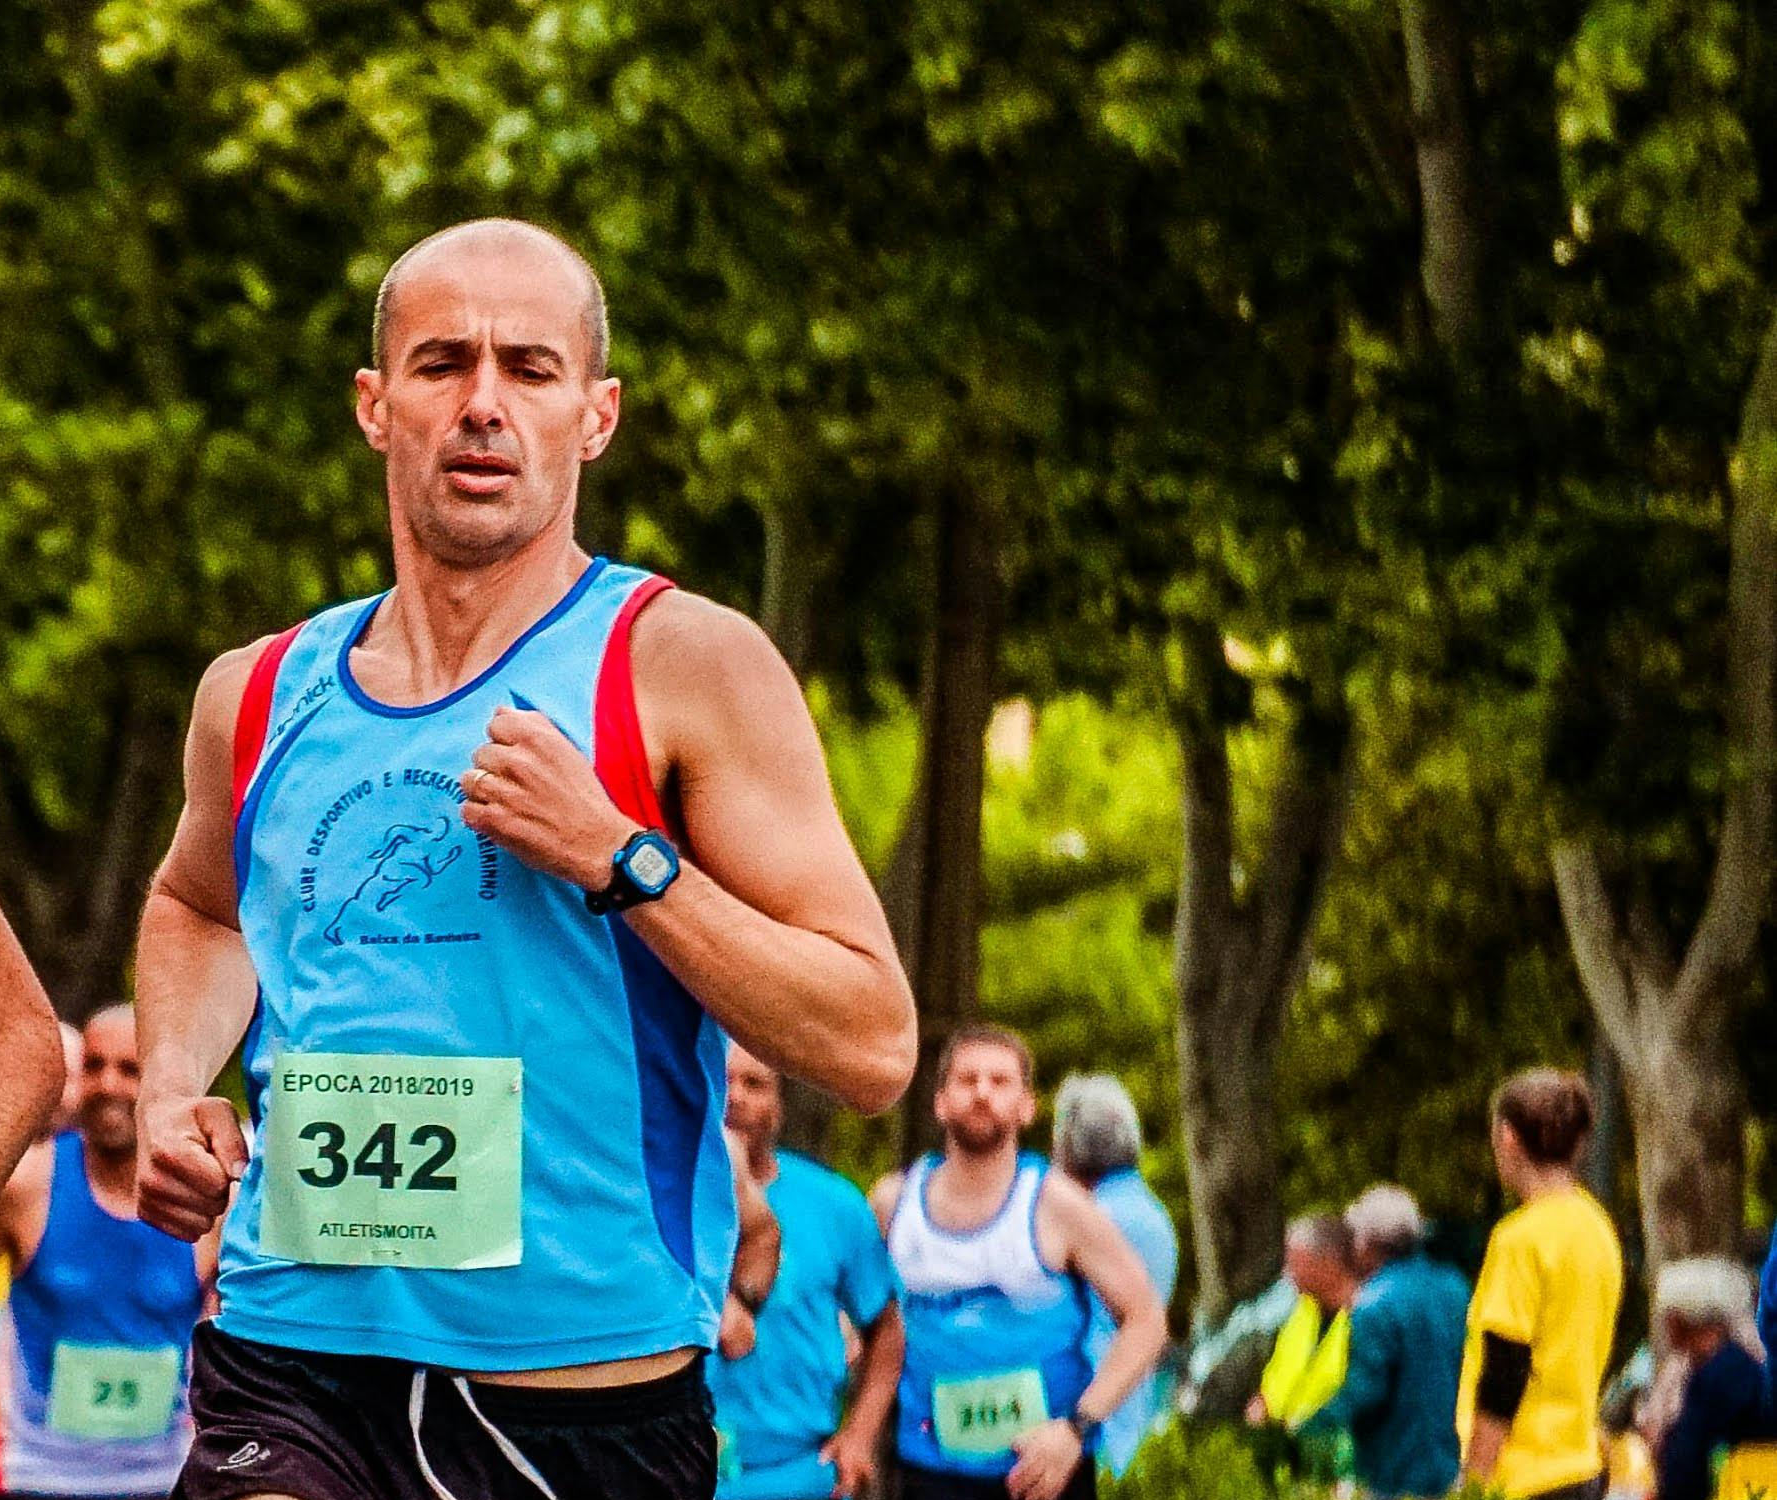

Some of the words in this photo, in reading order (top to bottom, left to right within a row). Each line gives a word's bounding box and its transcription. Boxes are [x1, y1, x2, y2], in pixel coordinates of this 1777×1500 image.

[383, 771, 394, 788] E
[403, 769, 470, 804] RECREATIV
[306, 780, 373, 856] DESPORTIVO
[300, 866, 318, 912] CLUBE
[283, 1069, 364, 1093] ÉPOCA
[369, 1075, 474, 1097] 2018/2019
[296, 1121, 458, 1191] 342
[318, 1223, 437, 1240] ATLETISMOITA
